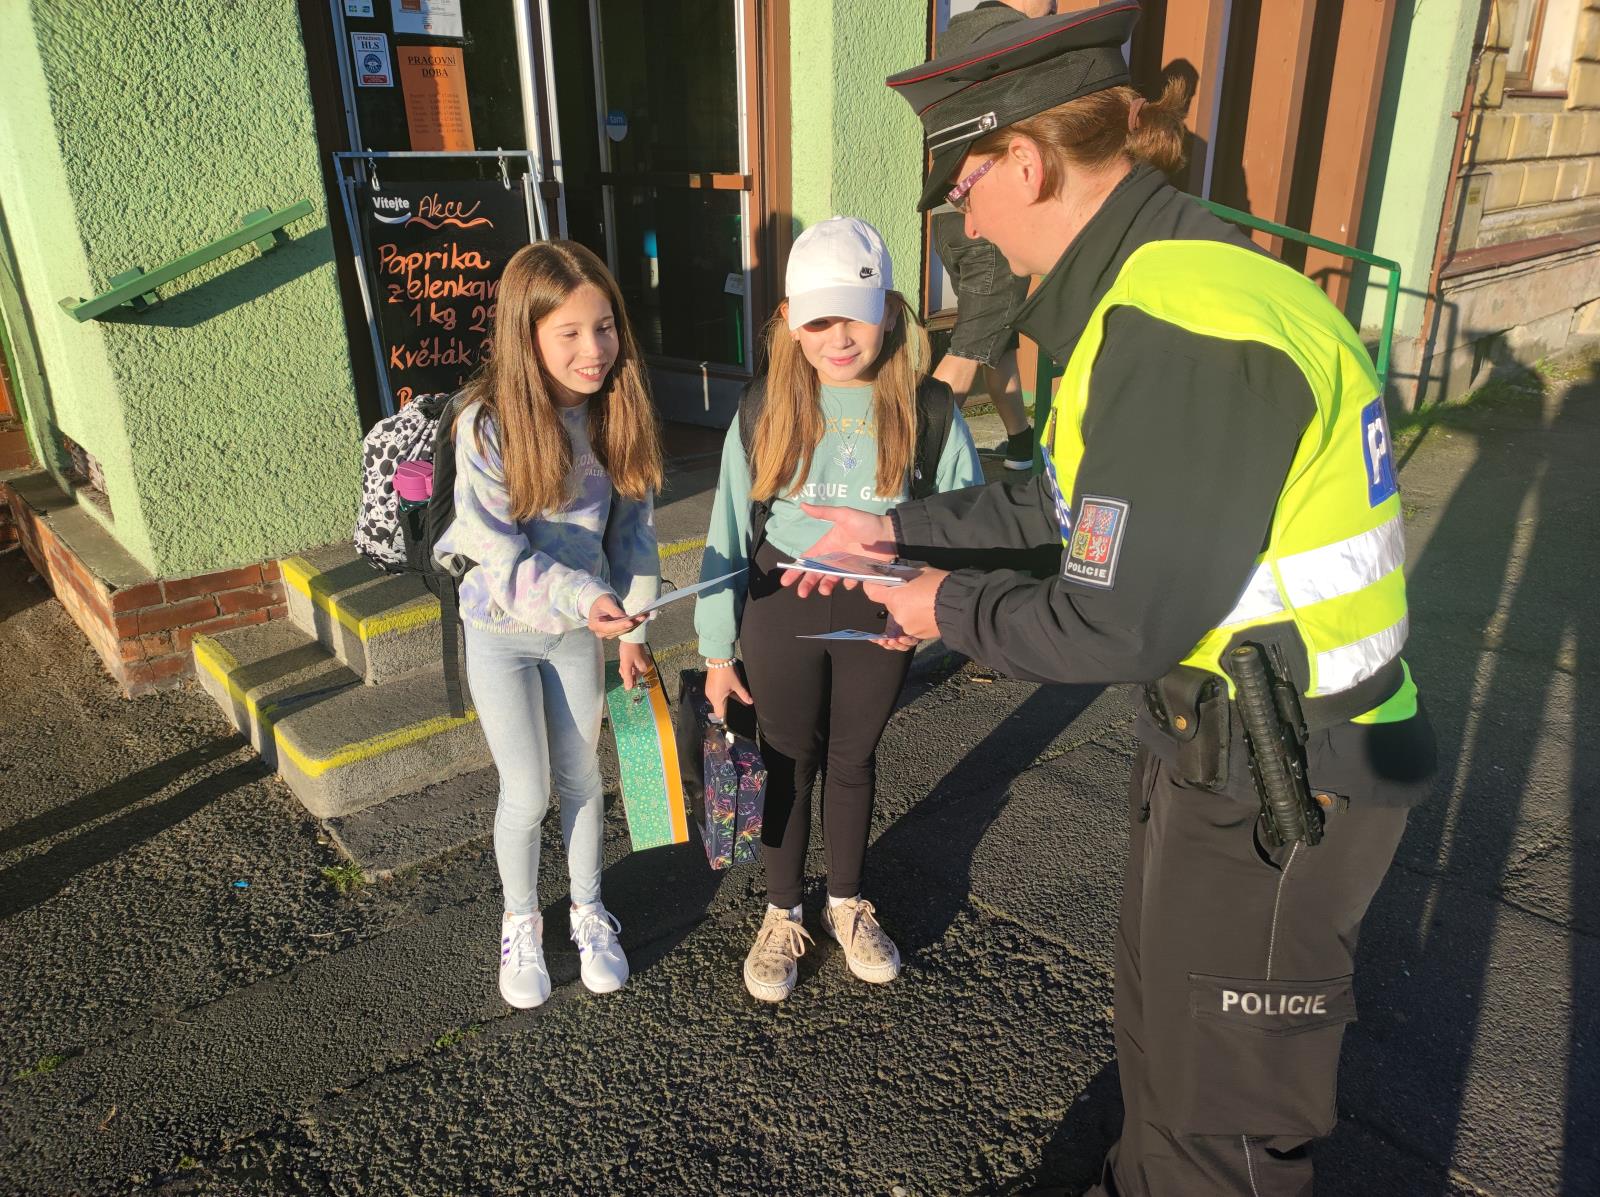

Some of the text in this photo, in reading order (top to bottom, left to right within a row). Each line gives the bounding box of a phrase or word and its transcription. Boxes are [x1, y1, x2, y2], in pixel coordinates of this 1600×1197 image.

[361, 41, 380, 50] HLS
[407, 55, 456, 65] PRACOVNÍ
[422, 68, 448, 78] DOBA
[417, 192, 481, 218] Akce
[378, 242, 491, 279] Paprika
[409, 303, 422, 326] 1
[430, 303, 457, 332] kg
[390, 336, 472, 370] Květák
[1067, 560, 1107, 579] POLICIE
[1222, 989, 1327, 1016] POLICIE
